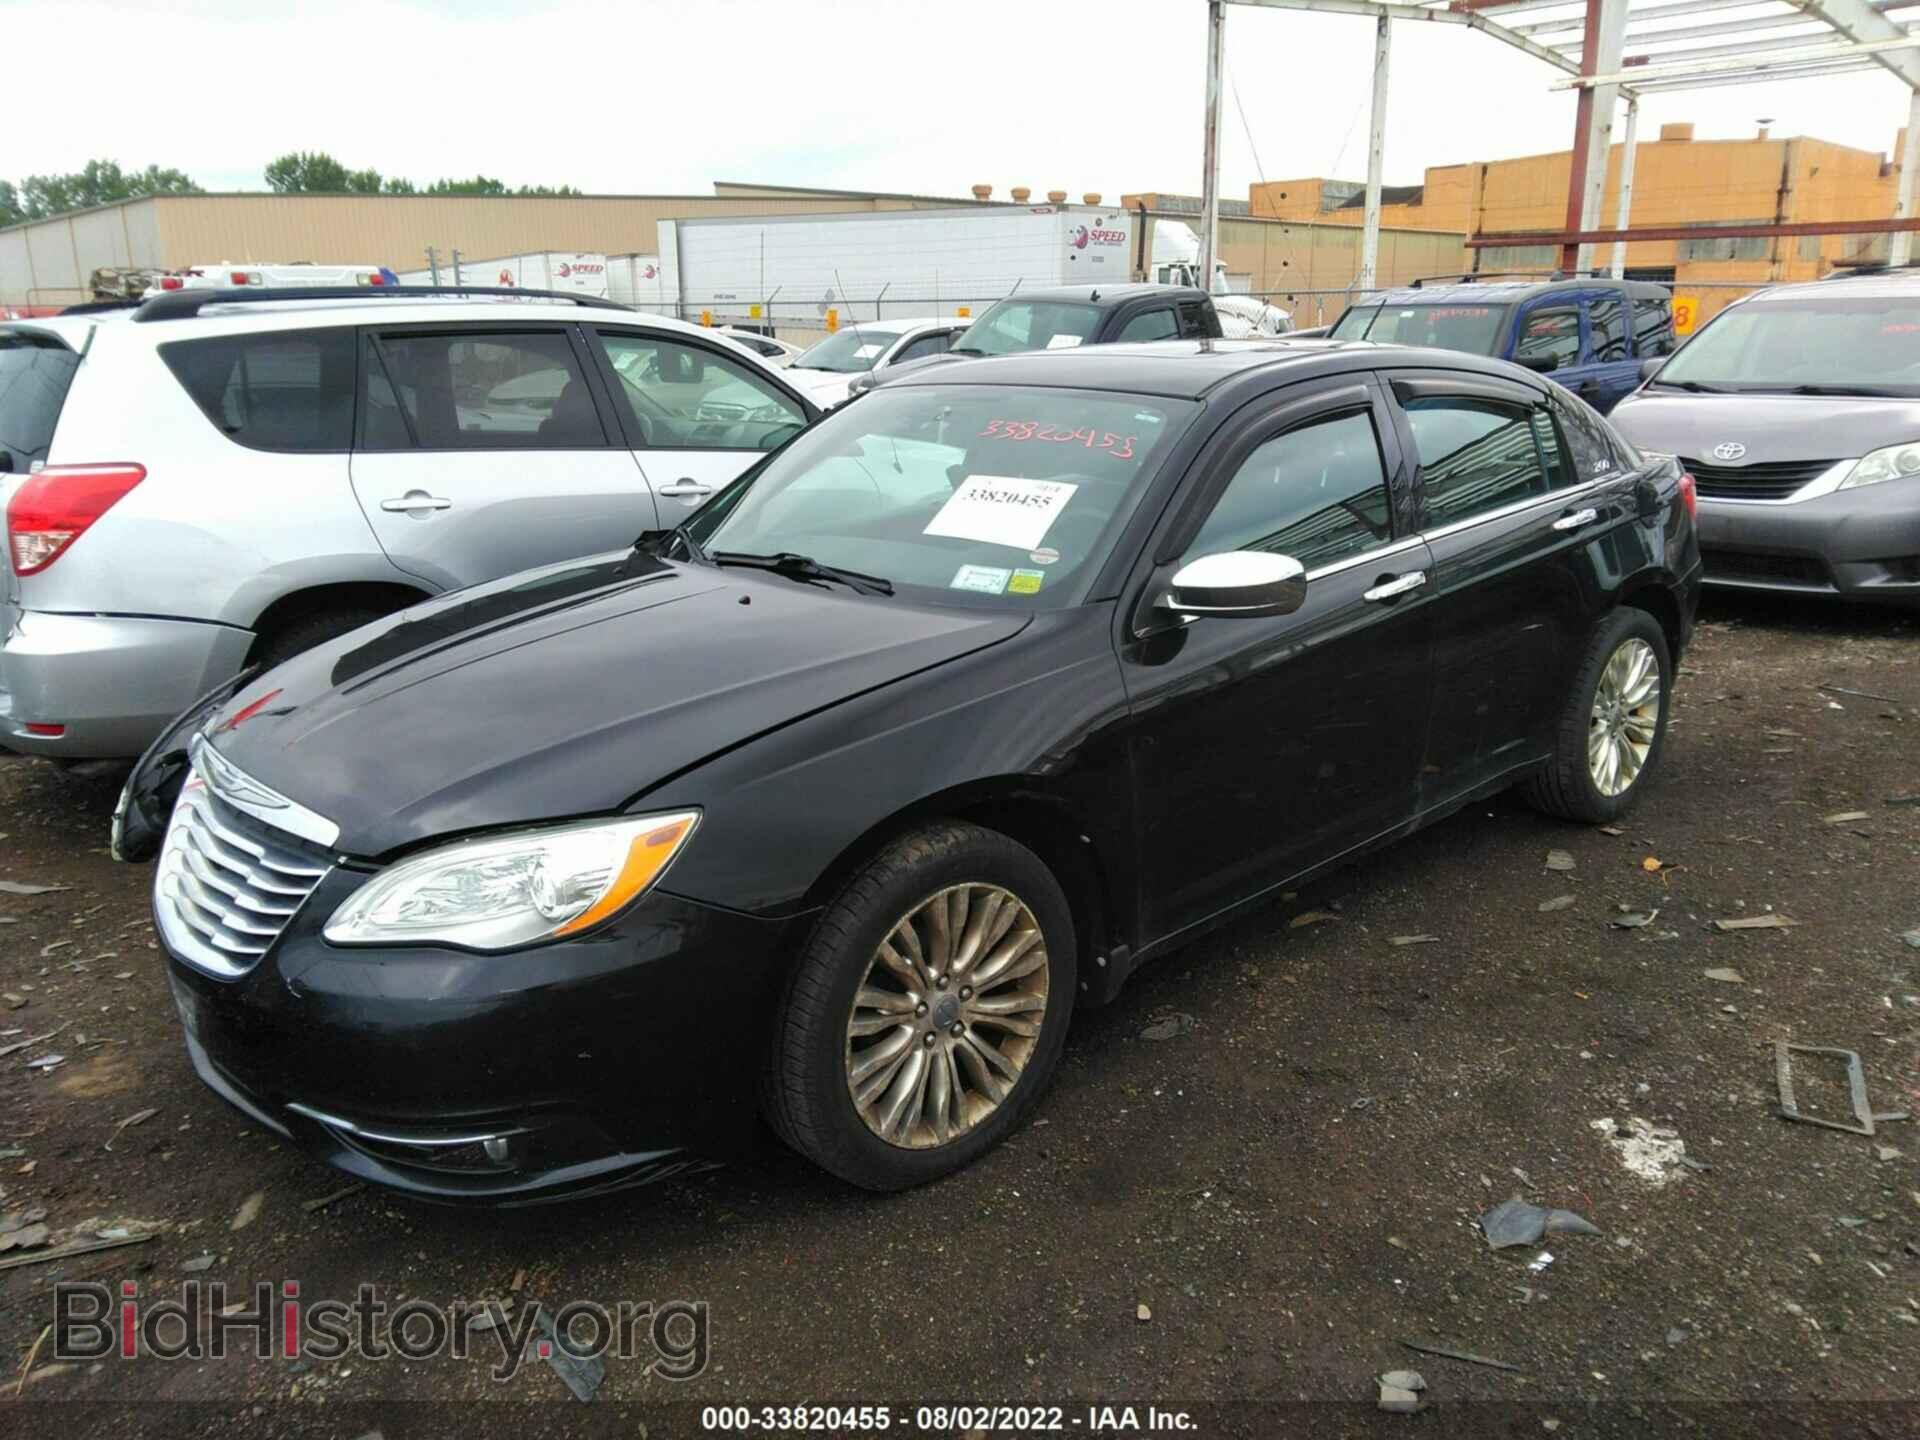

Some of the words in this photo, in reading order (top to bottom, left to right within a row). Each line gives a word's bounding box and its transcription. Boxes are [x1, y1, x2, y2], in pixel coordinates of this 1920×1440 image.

[1090, 230, 1126, 241] SPEED
[571, 263, 604, 273] SPEED
[976, 420, 1138, 460] 33820455
[962, 487, 1054, 508] 33820455
